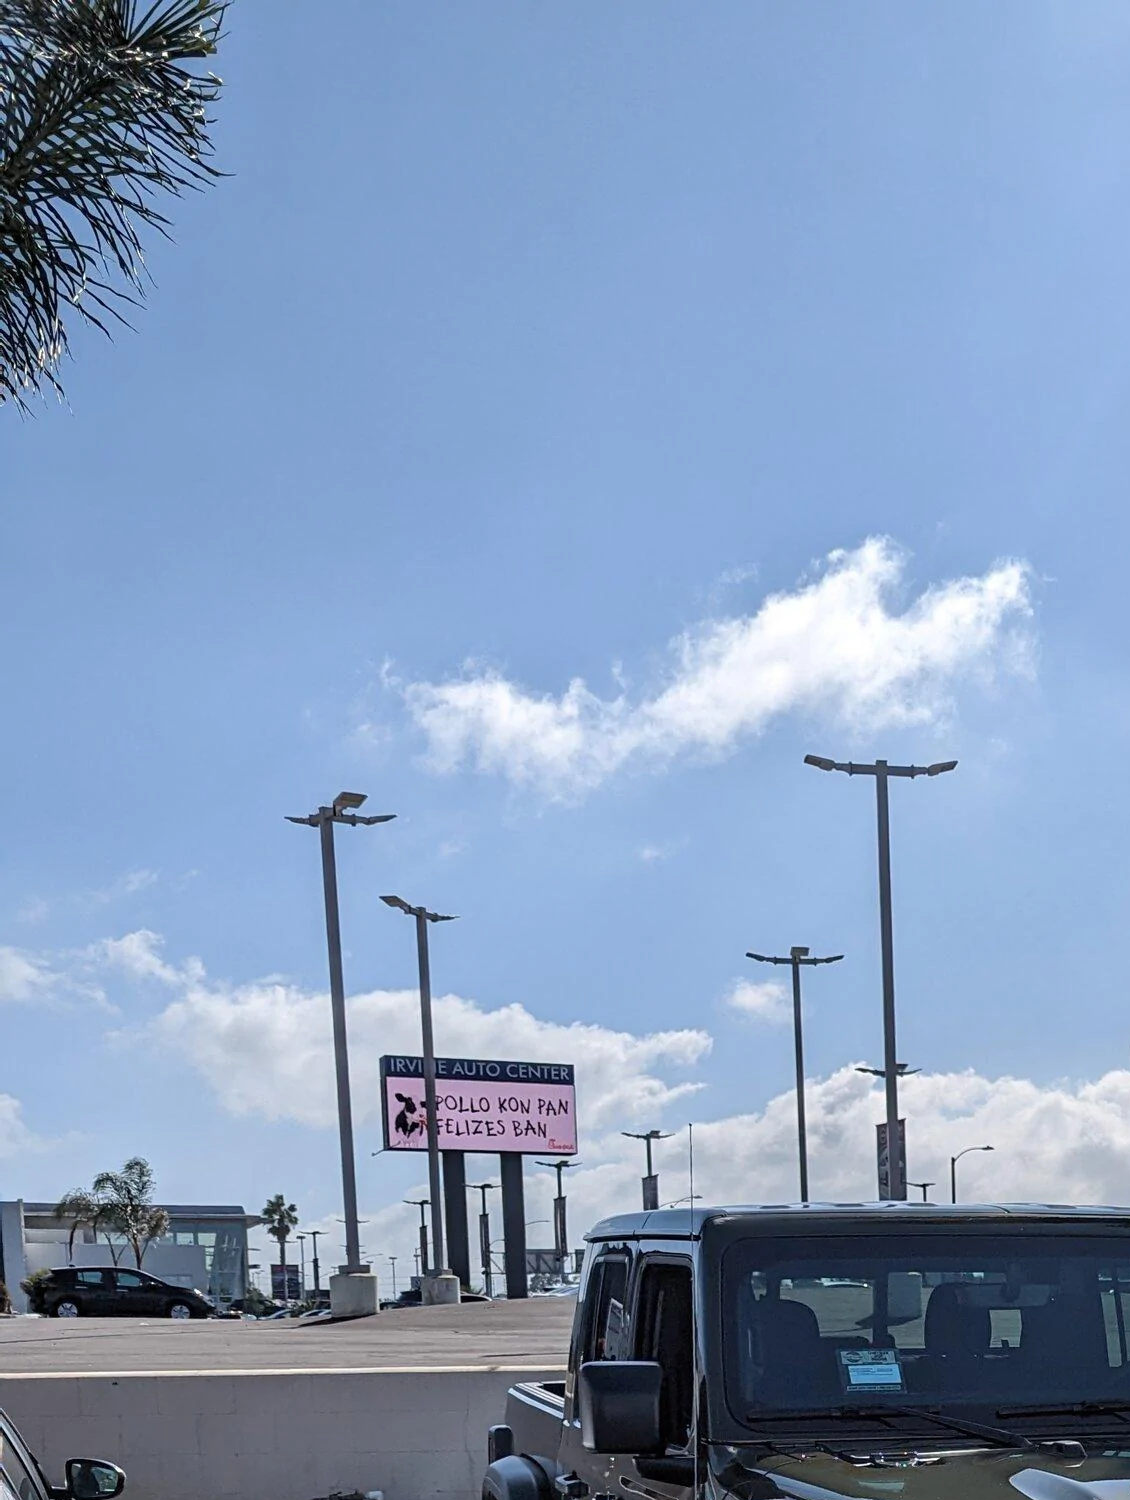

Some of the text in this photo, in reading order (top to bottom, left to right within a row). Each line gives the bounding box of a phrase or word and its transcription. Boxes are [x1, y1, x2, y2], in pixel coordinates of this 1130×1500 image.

[390, 1057, 569, 1080] IRVIE AUTO CENTER
[435, 1095, 568, 1116] POLLO KON PAN
[436, 1118, 546, 1138] FELIZES BAN
